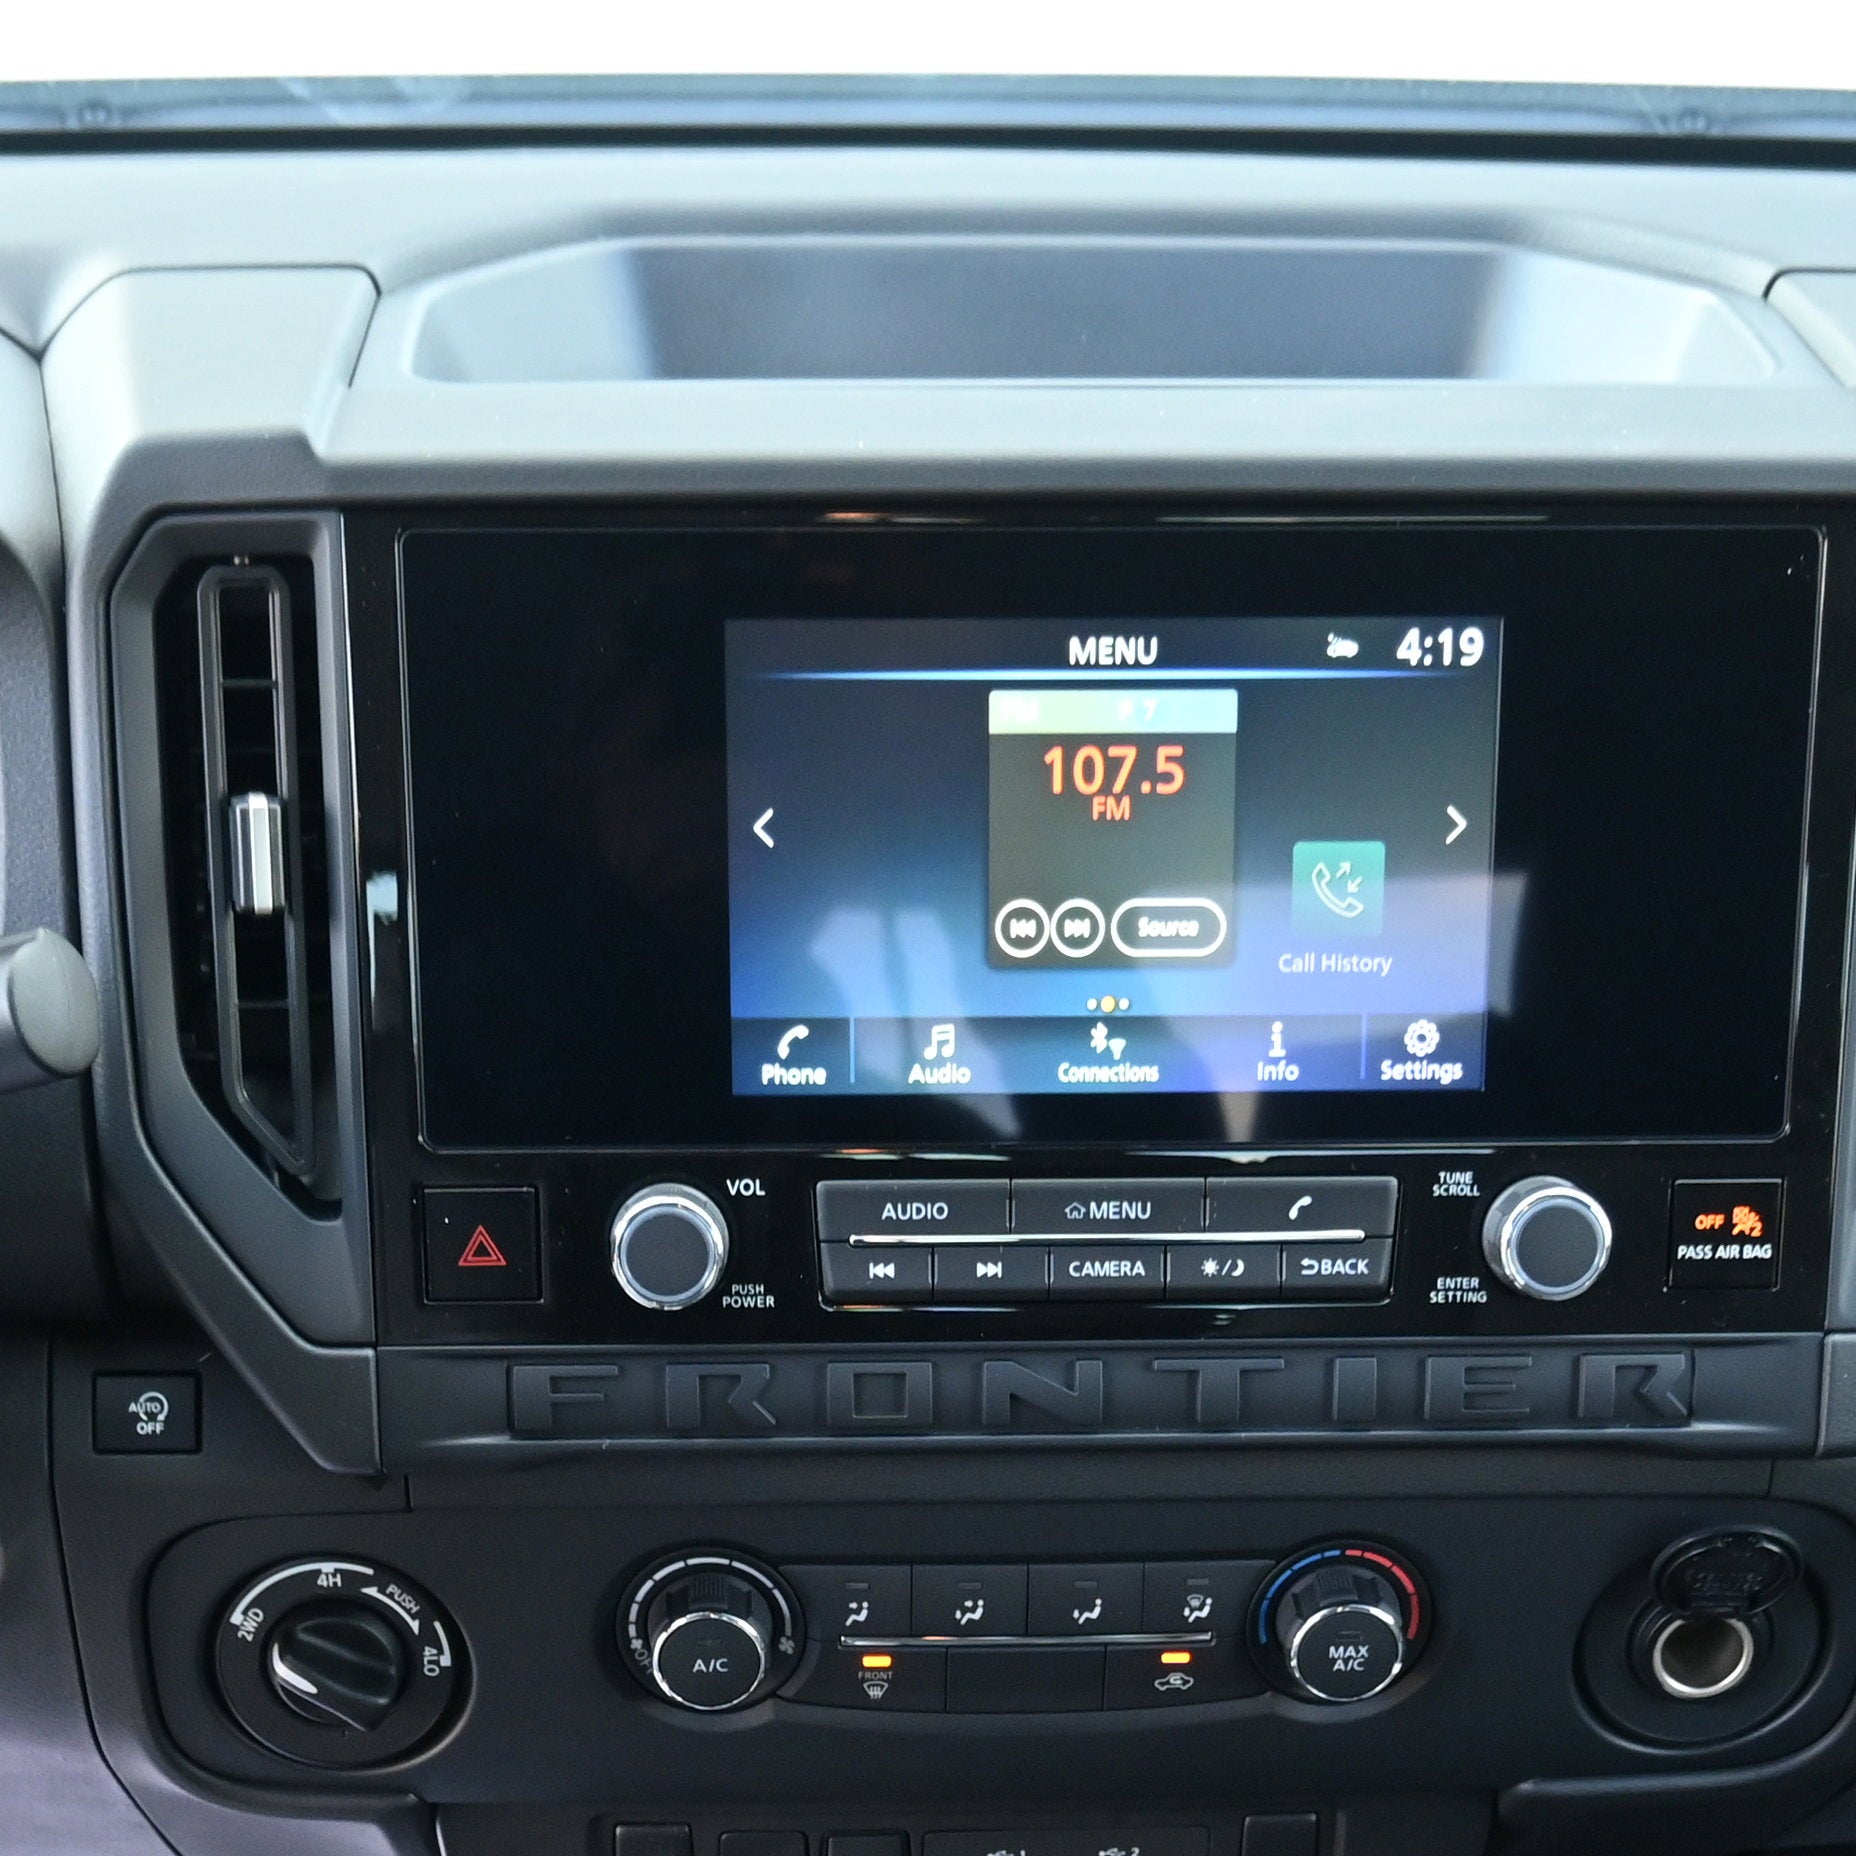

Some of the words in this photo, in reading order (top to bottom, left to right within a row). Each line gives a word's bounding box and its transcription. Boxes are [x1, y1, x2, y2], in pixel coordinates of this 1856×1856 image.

[1068, 636, 1159, 667] MENU
[1396, 626, 1485, 667] 4:19
[1044, 744, 1186, 796] 107.5
[1092, 794, 1132, 822] FM
[1137, 916, 1200, 938] Source
[1278, 952, 1315, 974] Call
[1320, 953, 1393, 978] History
[761, 1064, 828, 1086] Phone
[908, 1063, 972, 1086] Audio
[1057, 1063, 1160, 1084] Connections
[1256, 1061, 1300, 1083] Info
[1380, 1060, 1464, 1085] Settings
[726, 1178, 766, 1197] VOL
[1438, 1171, 1473, 1185] TUNE
[1432, 1184, 1481, 1197] SCROLL
[882, 1202, 949, 1222] AUDIO
[1089, 1200, 1152, 1220] MENU
[1694, 1214, 1724, 1230] OFF
[1677, 1244, 1712, 1260] PASS
[1714, 1244, 1740, 1260] AIR
[1742, 1243, 1772, 1259] BAG
[1068, 1260, 1146, 1279] CAMERA
[1319, 1257, 1370, 1276] BACK
[731, 1283, 765, 1295] PUSH
[1436, 1276, 1480, 1290] ENTER
[722, 1295, 775, 1308] POWER
[1429, 1290, 1488, 1304] SETTING
[508, 1352, 1694, 1434] FRONTIER
[127, 1400, 162, 1413] AUTO
[136, 1421, 165, 1435] OFF
[317, 1573, 342, 1589] 4H
[385, 1584, 421, 1613] PUSH
[237, 1606, 265, 1642] 2WD
[423, 1644, 440, 1677] 4LO
[1328, 1644, 1369, 1659] MAX
[693, 1657, 729, 1673] A/C
[1332, 1658, 1365, 1671] A/C
[858, 1671, 893, 1681] FRONT
